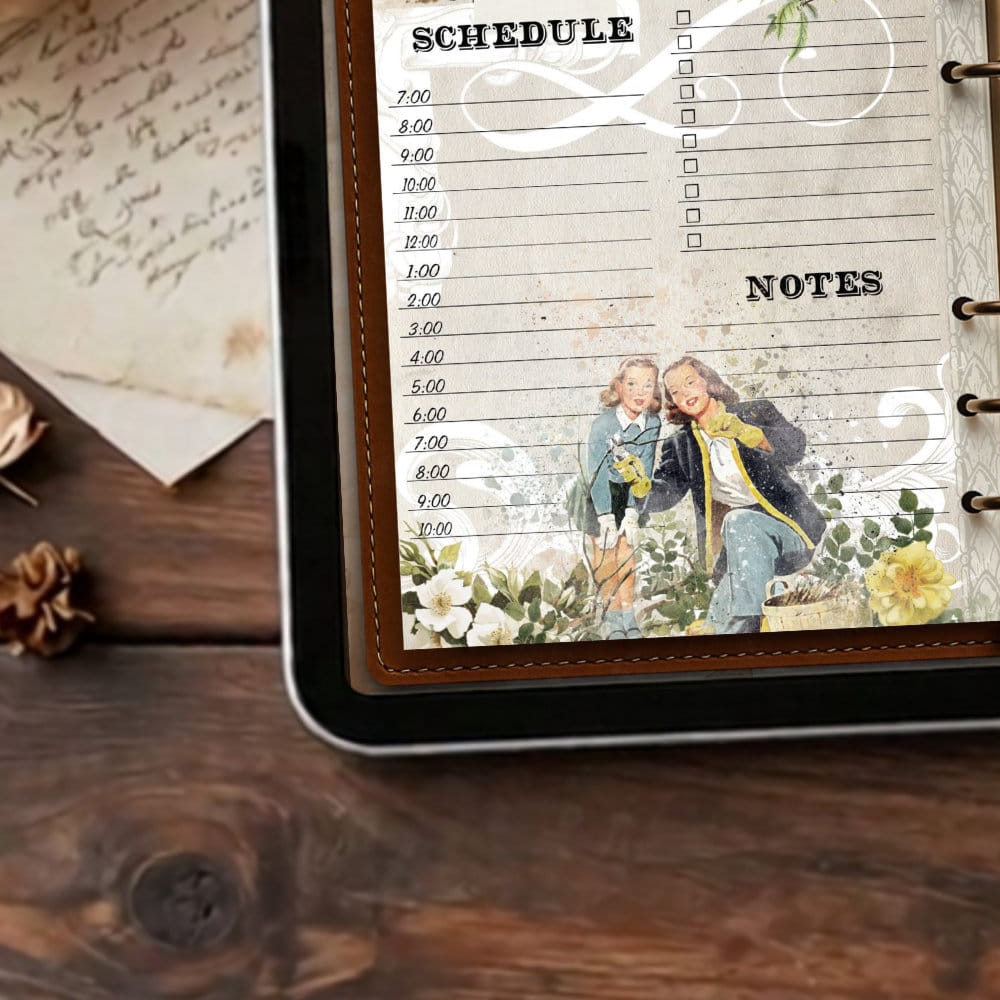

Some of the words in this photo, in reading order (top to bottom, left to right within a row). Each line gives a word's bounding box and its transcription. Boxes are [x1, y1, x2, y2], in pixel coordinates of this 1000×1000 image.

[412, 16, 634, 53] SCHEDULE
[397, 89, 431, 105] 7:00
[398, 119, 433, 134] 8:00
[400, 147, 434, 162] 9:00
[402, 176, 436, 191] 10:00
[403, 205, 437, 220] 11:00
[404, 234, 438, 249] 12:00
[406, 263, 440, 278] 1:00
[746, 270, 883, 301] NOTES
[407, 293, 441, 307] 2:00
[408, 321, 443, 336] 3:00
[410, 350, 444, 364] 4:00
[411, 378, 446, 393] 5:00
[412, 407, 447, 422] 6:00
[414, 435, 448, 450] 7:00
[415, 464, 450, 479] 8:00
[417, 493, 451, 508] 9:00
[418, 522, 453, 537] 10:00
